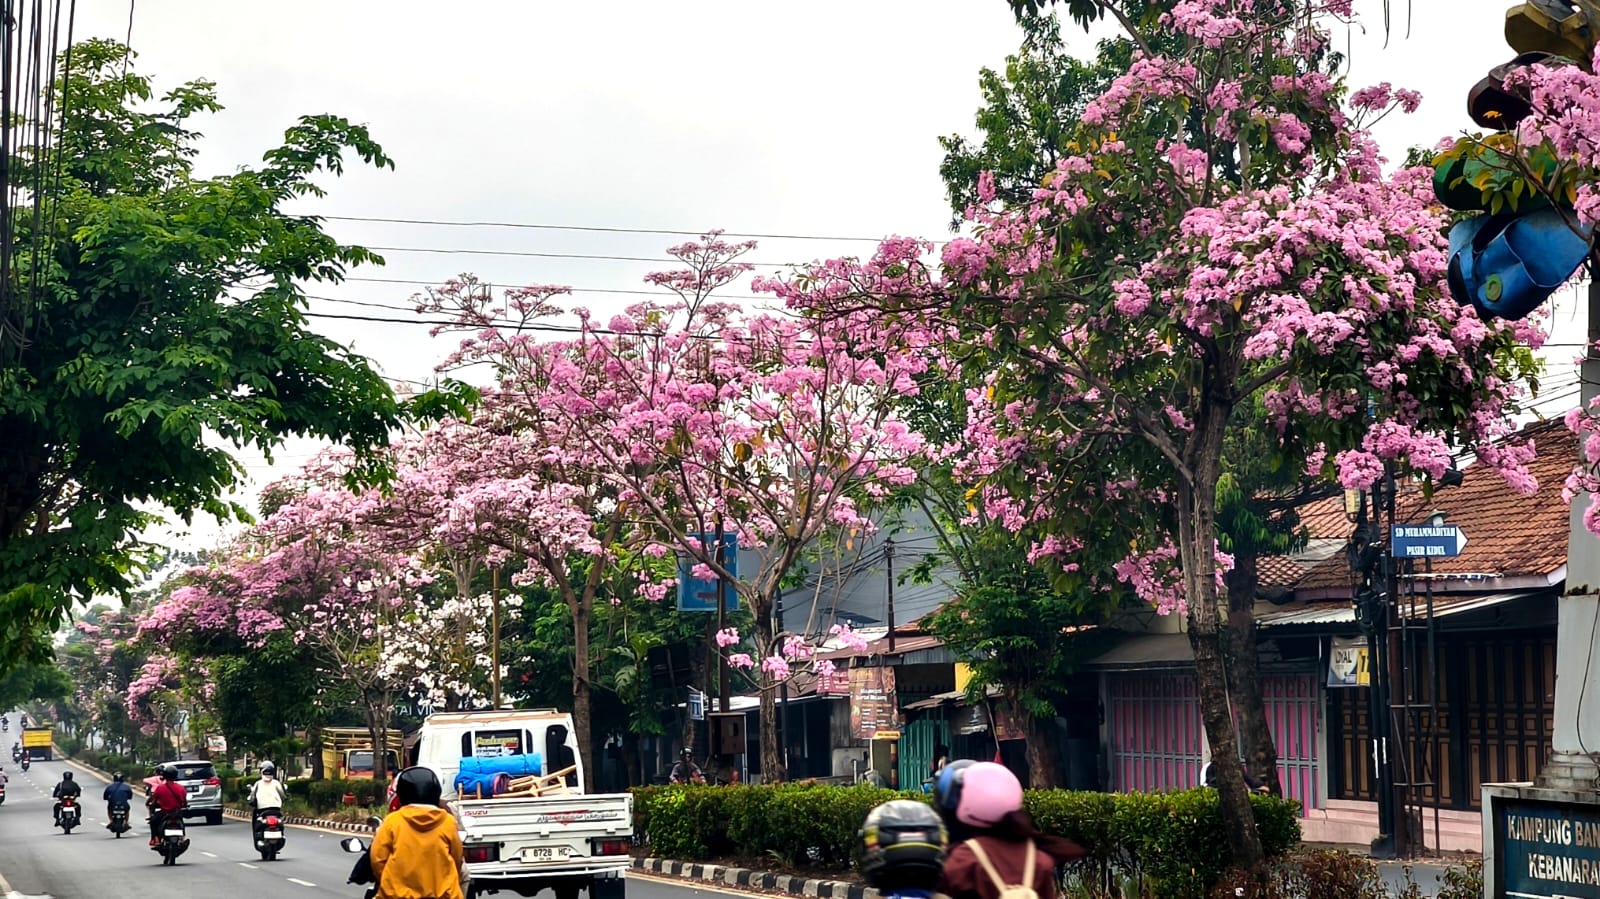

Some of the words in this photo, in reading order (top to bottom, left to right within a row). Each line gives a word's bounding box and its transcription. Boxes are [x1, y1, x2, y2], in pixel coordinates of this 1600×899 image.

[1395, 528, 1404, 537] SD
[1406, 546, 1425, 556] PASIR
[1426, 546, 1446, 556] KIDUL
[1507, 815, 1572, 845] KAMPUNG
[1528, 853, 1600, 886] KEBANARA
